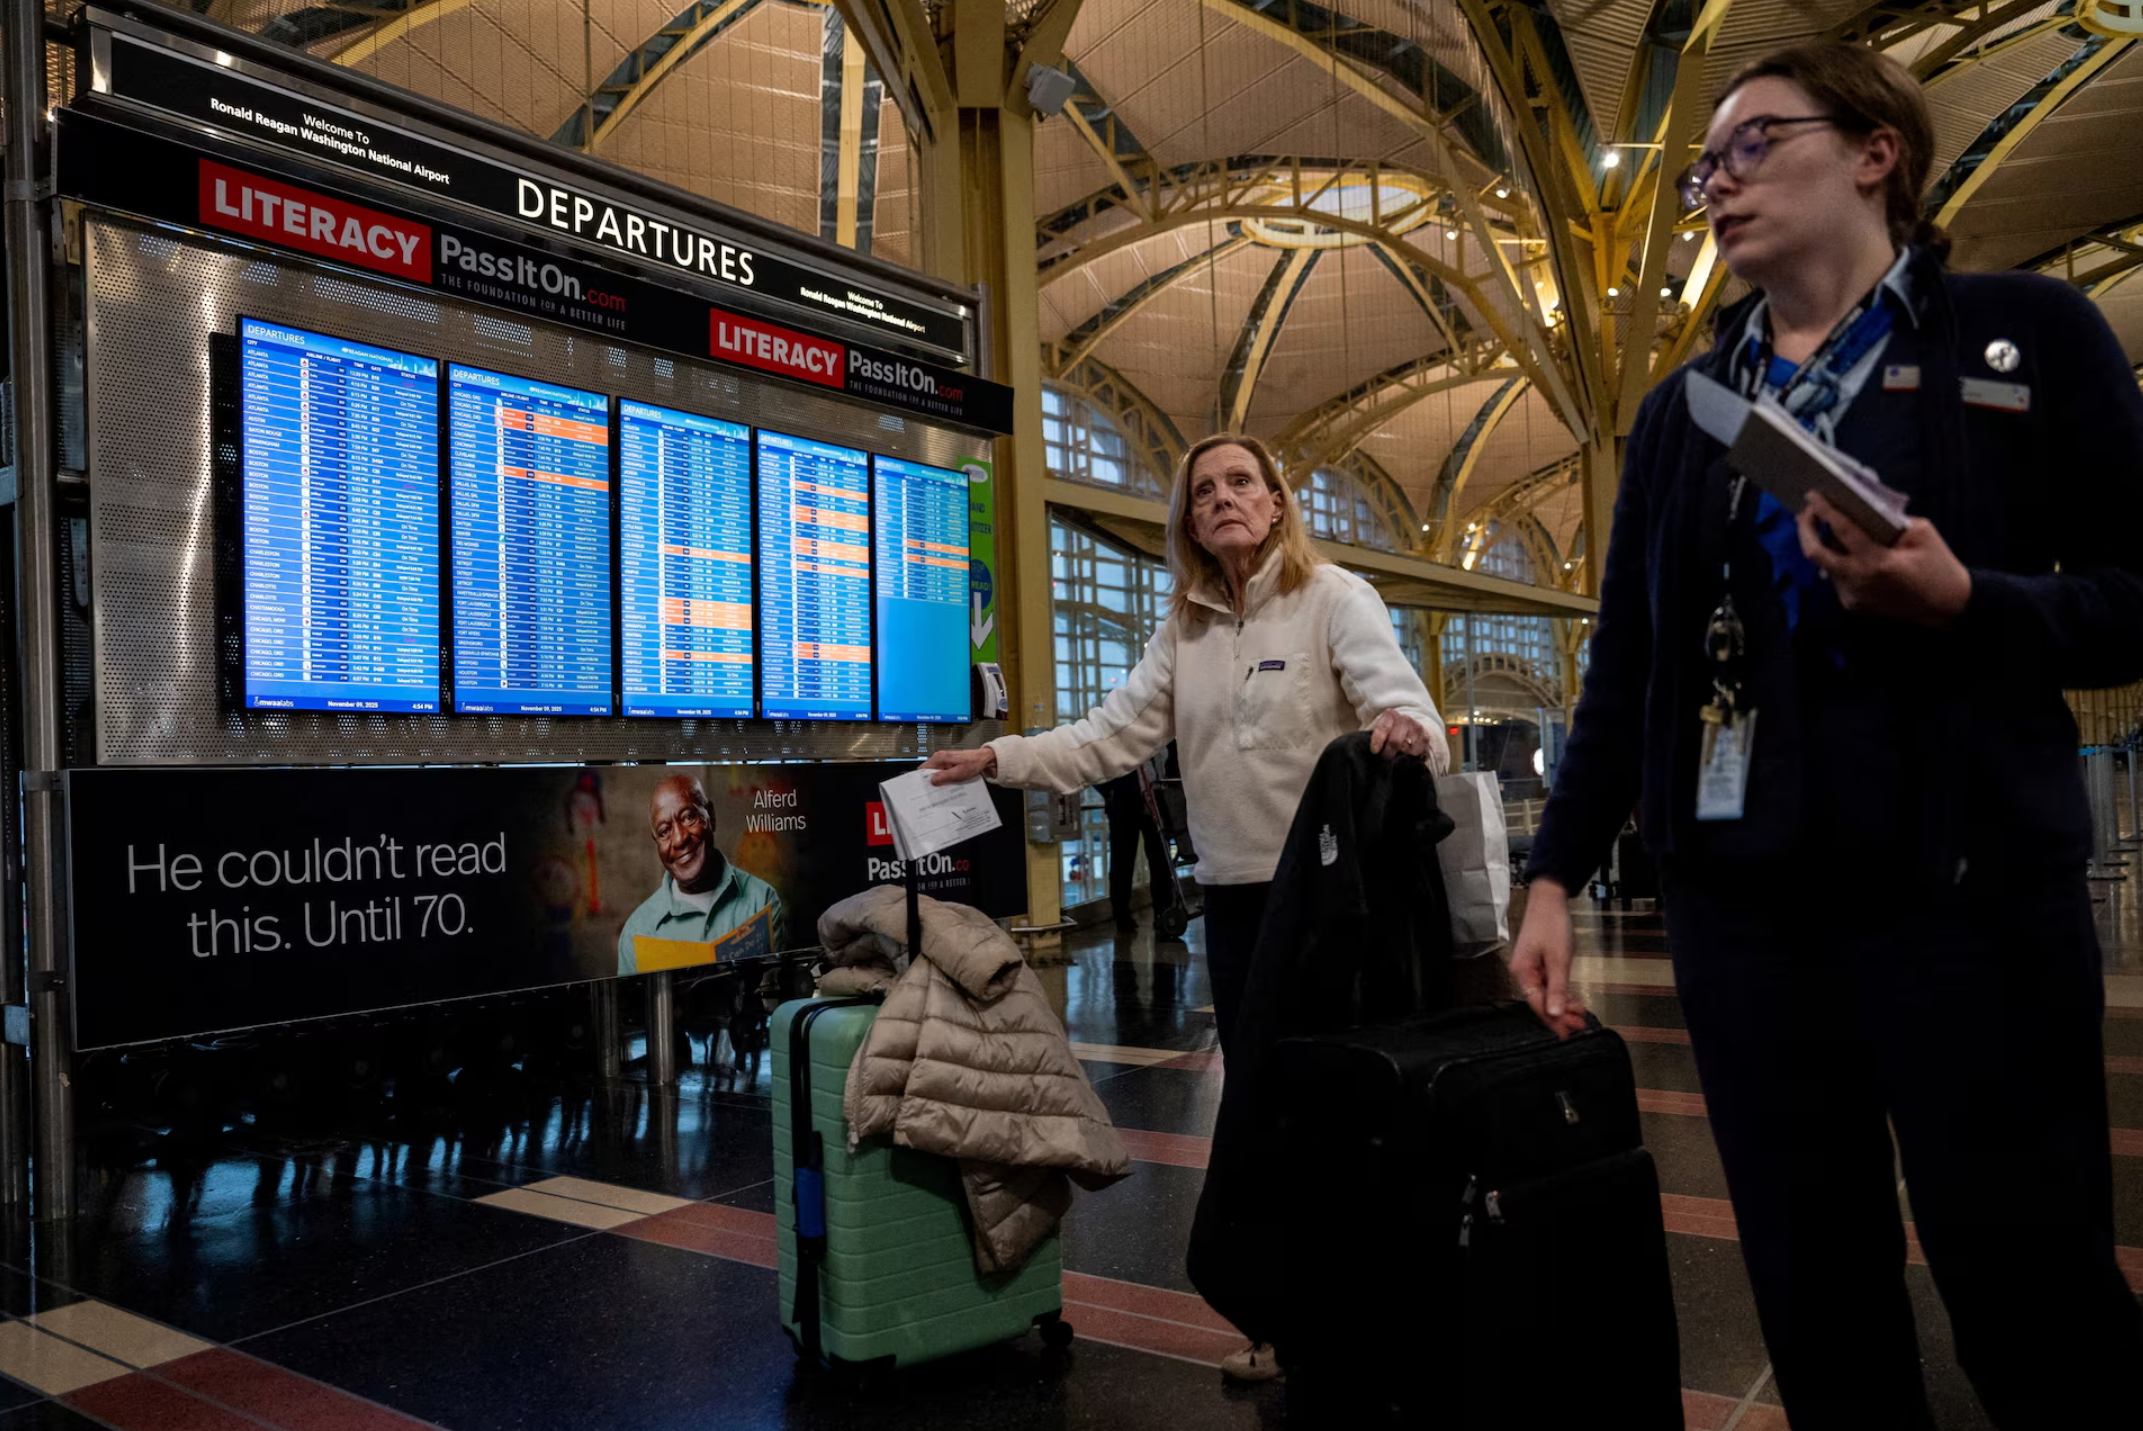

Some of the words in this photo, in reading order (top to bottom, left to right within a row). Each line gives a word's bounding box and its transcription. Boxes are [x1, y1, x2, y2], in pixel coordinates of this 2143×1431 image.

[303, 113, 354, 140] Welcome
[355, 129, 370, 145] To
[210, 97, 253, 124] Ronald
[255, 109, 298, 137] Reagan
[299, 124, 366, 160] Washington
[367, 146, 412, 174] National
[413, 160, 450, 185] Airport
[215, 178, 421, 266] LITERACY
[516, 178, 755, 287] DEPARTURES
[441, 233, 627, 312] PassItOn.com
[441, 273, 462, 289] THE
[467, 279, 536, 308] FOUNDATION
[540, 298, 556, 312] FOR
[560, 304, 565, 315] A
[570, 306, 603, 325] BETTER
[607, 315, 626, 331] LIFE
[847, 291, 875, 308] Welcome
[875, 299, 884, 310] To
[800, 286, 823, 302] Ronald
[823, 293, 846, 309] Reagan
[846, 301, 882, 319] Washington
[881, 311, 906, 327] National
[905, 319, 926, 334] Airport
[247, 324, 305, 345] DEPARTURES
[247, 348, 268, 358] ATLANTA
[718, 321, 838, 376] LITERACY
[305, 351, 322, 360] AIRLINE
[326, 355, 341, 364] FLIGHT
[247, 359, 268, 369] ATLANTA
[247, 370, 268, 380] ATLANTA
[400, 371, 415, 379] STATUS
[453, 368, 500, 386] DEPARTURES
[849, 349, 963, 402] PassItOn.com
[247, 381, 268, 391] ATLANTA
[247, 393, 268, 402] ATLANTA
[849, 380, 862, 391] THE
[865, 383, 908, 402] FOUNDATION
[921, 398, 926, 406] A
[927, 399, 949, 412] BETTER
[950, 405, 963, 416] LIFE
[247, 404, 268, 413] ATLANTA
[623, 404, 661, 419] DEPARTURES
[247, 415, 265, 423] AUSTIN
[248, 437, 279, 448] BIRMINGHAM
[248, 448, 268, 457] BOSTON
[248, 459, 268, 468] BOSTON
[248, 470, 268, 479] BOSTON
[248, 481, 268, 490] BOSTON
[248, 492, 268, 501] BOSTON
[248, 504, 268, 512] BOSTON
[249, 515, 268, 523] BOSTON
[249, 526, 269, 534] BOSTON
[249, 537, 269, 545] BOSTON
[249, 548, 279, 557] CHARLESTON
[249, 559, 279, 568] CHARLESTON
[249, 570, 280, 579] CHARLESTON
[249, 604, 285, 612] CHATTANOOGA
[258, 698, 293, 707] mwaalabs
[465, 704, 493, 712] mwaalabs
[753, 788, 798, 810] Alferd
[745, 812, 807, 835] Williams
[128, 843, 203, 893] He
[416, 832, 507, 877] read
[939, 879, 944, 889] A
[945, 877, 967, 888] BETTER
[187, 905, 292, 958] this.
[305, 896, 402, 947] Until
[413, 893, 474, 938] 70.
